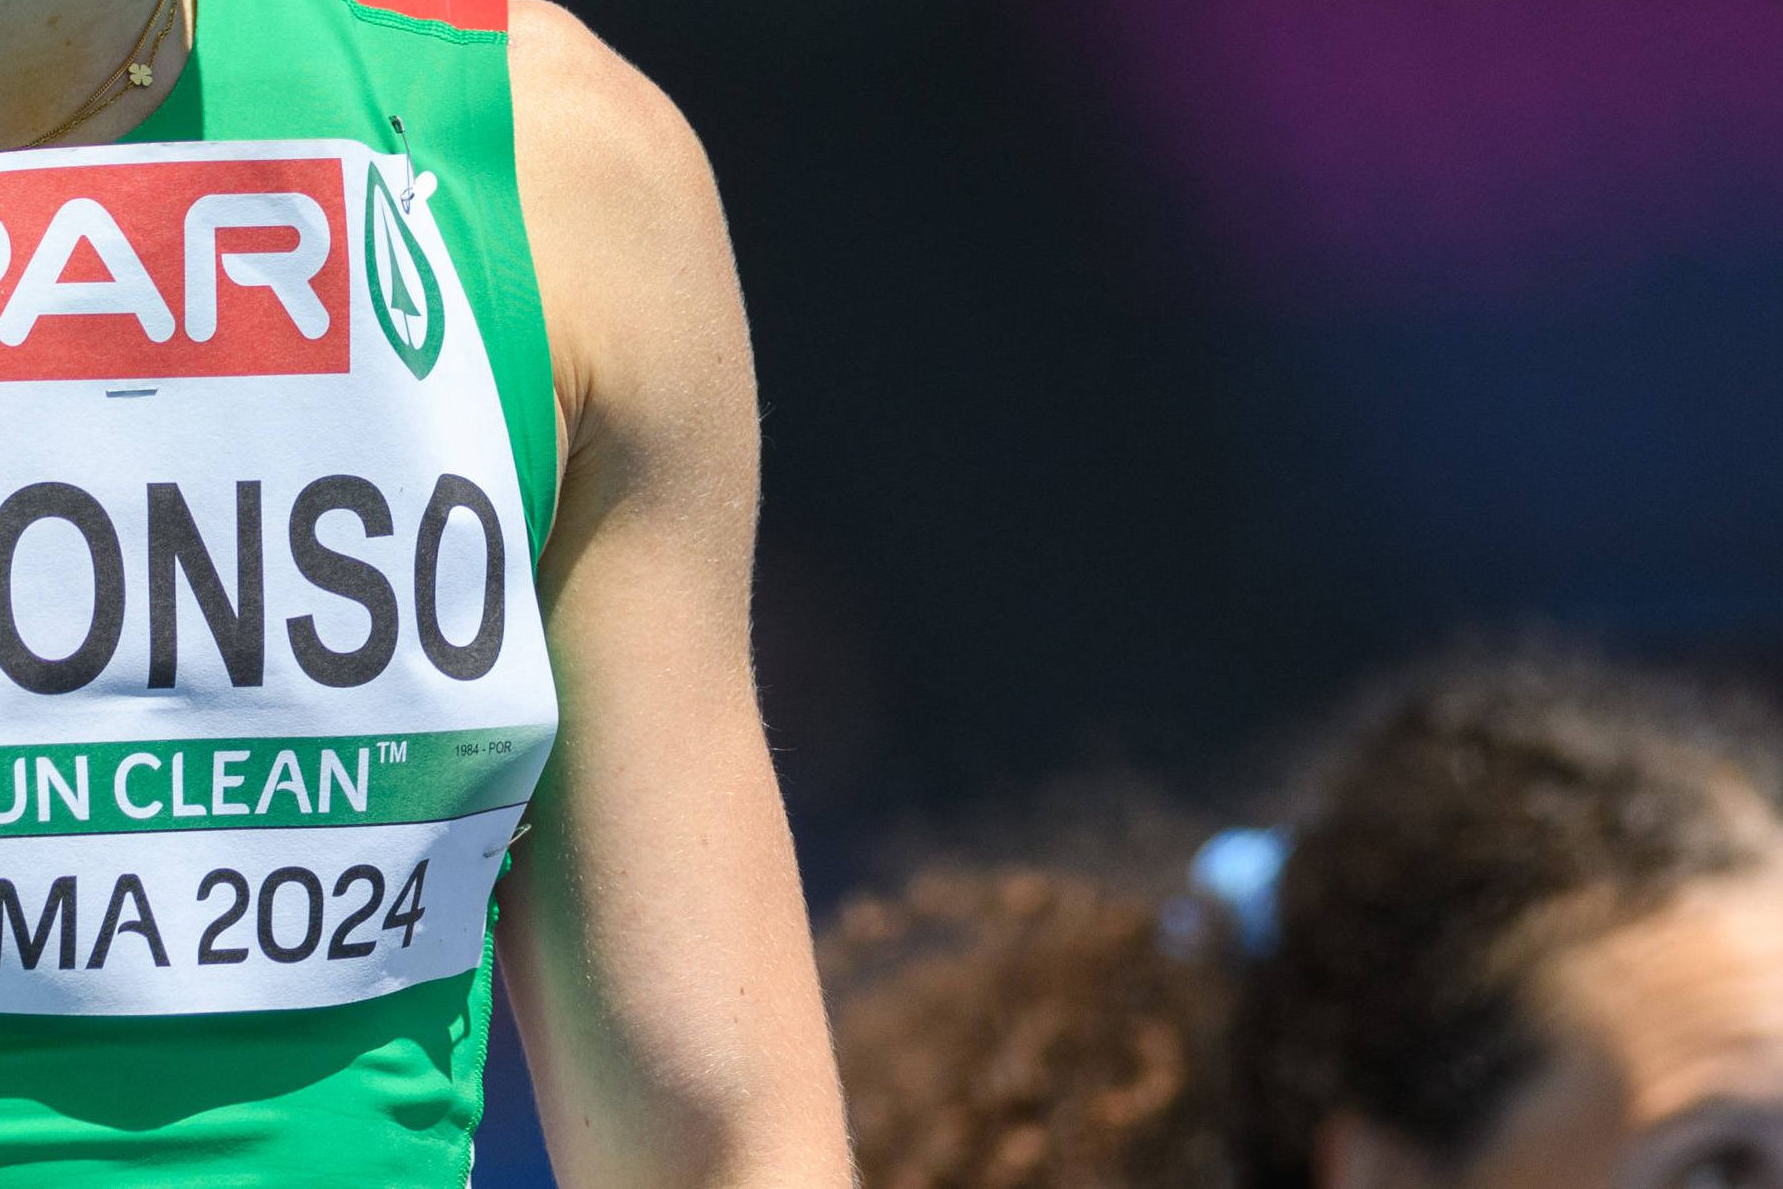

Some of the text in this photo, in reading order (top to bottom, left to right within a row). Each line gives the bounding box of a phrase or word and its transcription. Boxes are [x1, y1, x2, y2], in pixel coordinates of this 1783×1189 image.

[455, 743, 479, 757] 1984
[489, 740, 512, 755] POR
[196, 857, 430, 965] 2024
